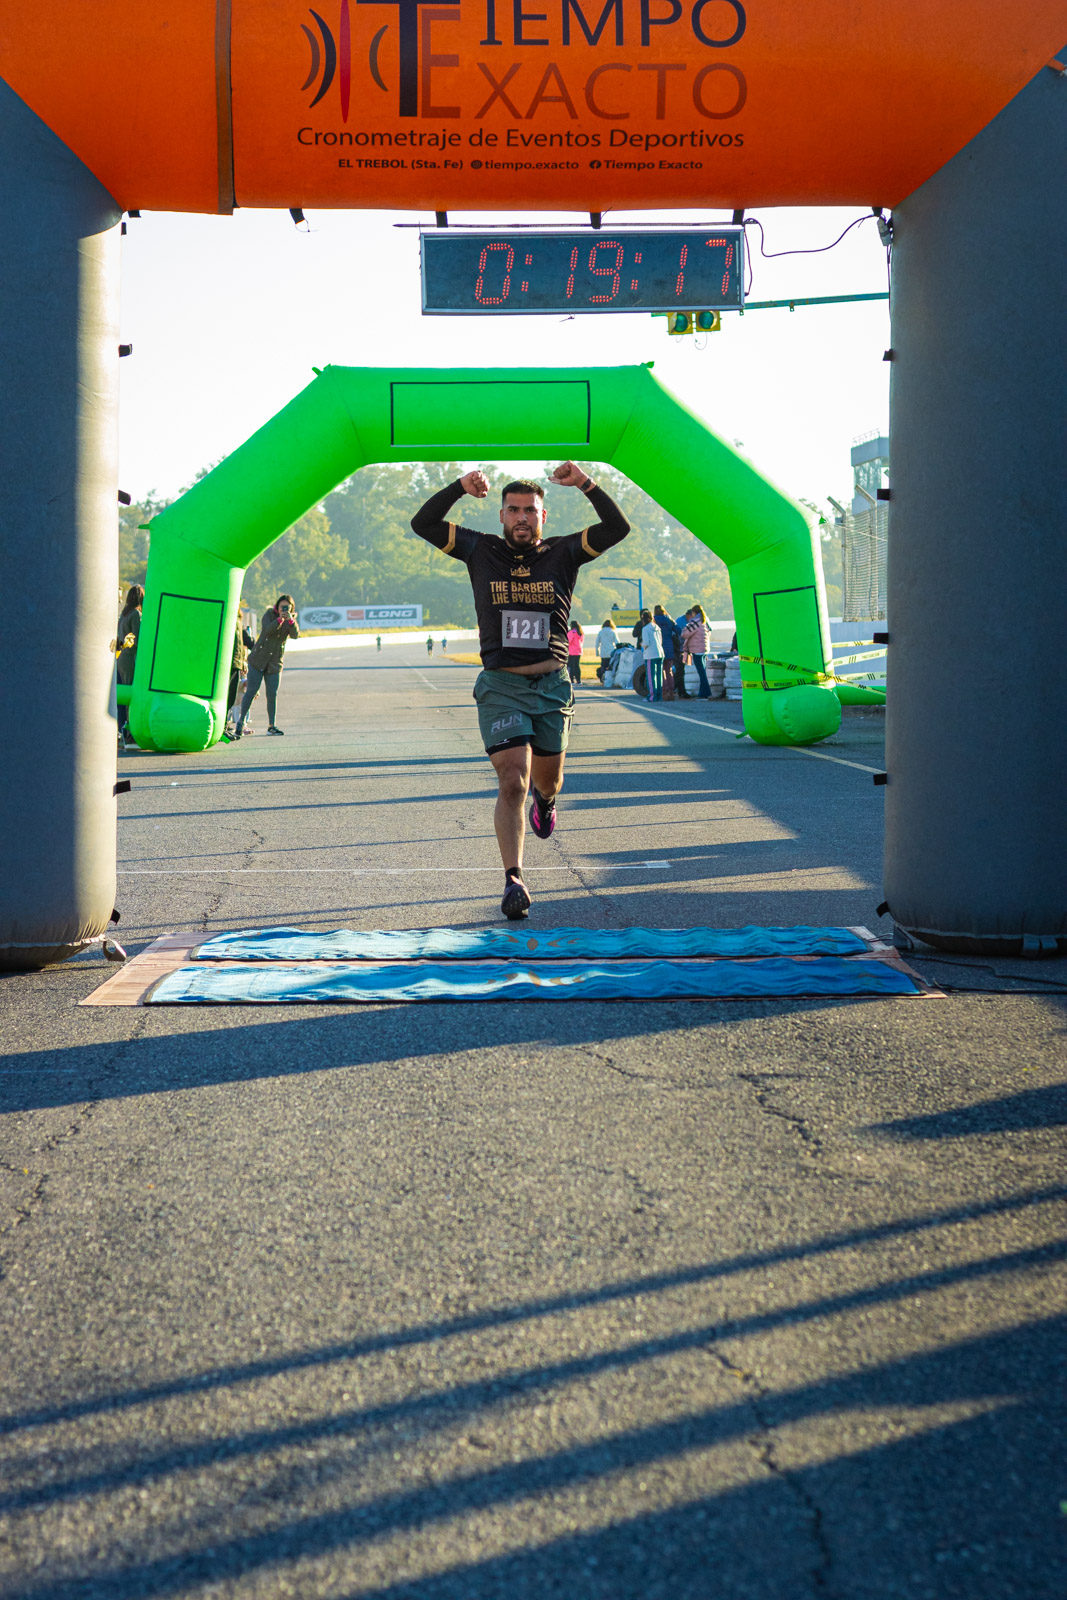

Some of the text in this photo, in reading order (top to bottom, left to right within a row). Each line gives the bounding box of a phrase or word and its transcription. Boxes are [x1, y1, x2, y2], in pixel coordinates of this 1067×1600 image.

[297, 127, 745, 151] Cronometraje de Eventos Deportivos
[338, 159, 354, 169] EL
[356, 159, 408, 169] TREBOL
[411, 159, 441, 170] (Sta.
[444, 160, 464, 170] Fe)
[604, 160, 655, 172] Tiempo
[658, 160, 703, 170] Exacto
[490, 581, 554, 593] THE BARBERS
[368, 610, 413, 618] LONG
[511, 619, 540, 640] 121
[491, 713, 523, 733] RUN
